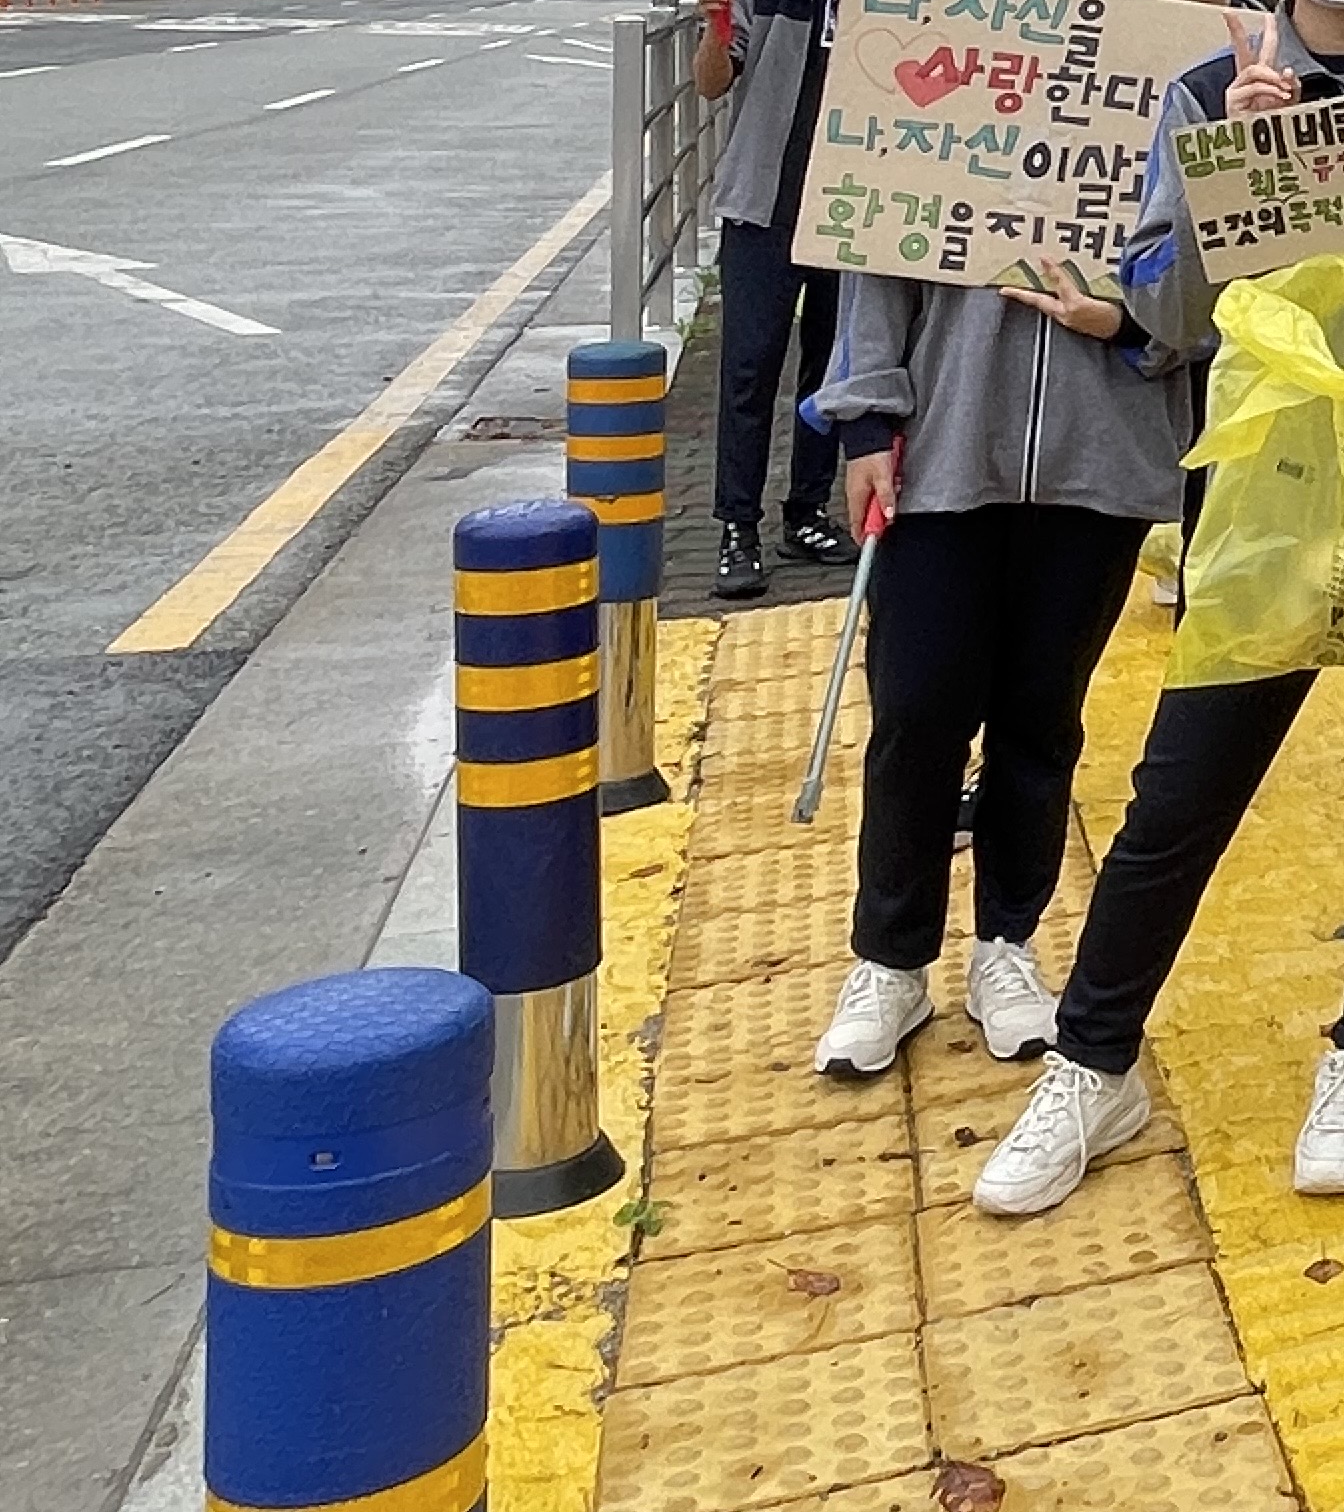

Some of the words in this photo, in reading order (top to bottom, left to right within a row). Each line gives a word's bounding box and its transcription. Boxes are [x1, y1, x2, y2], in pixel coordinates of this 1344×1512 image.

[917, 46, 1160, 127] 사랑한다
[1176, 115, 1288, 177] 당신이
[816, 173, 974, 272] 환경을
